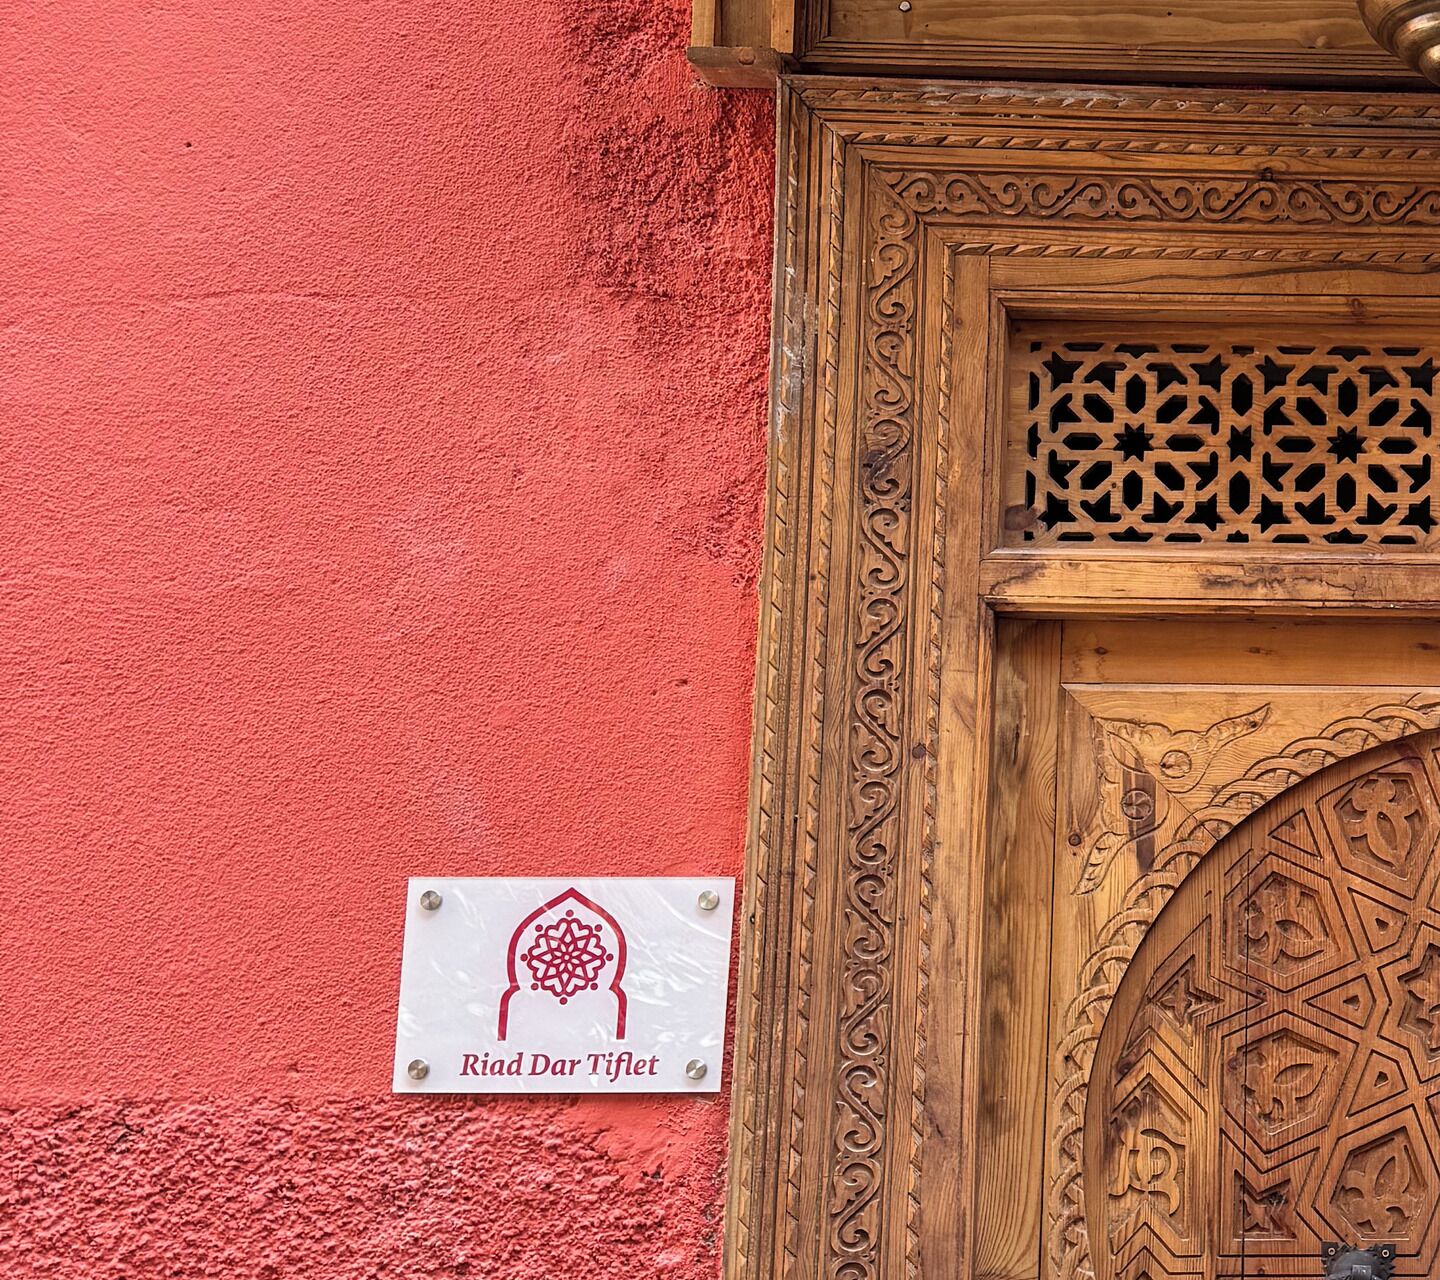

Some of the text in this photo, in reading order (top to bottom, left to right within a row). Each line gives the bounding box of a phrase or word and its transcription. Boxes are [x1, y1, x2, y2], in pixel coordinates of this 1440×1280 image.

[459, 1051, 660, 1083] Riad Dar Tiflet
